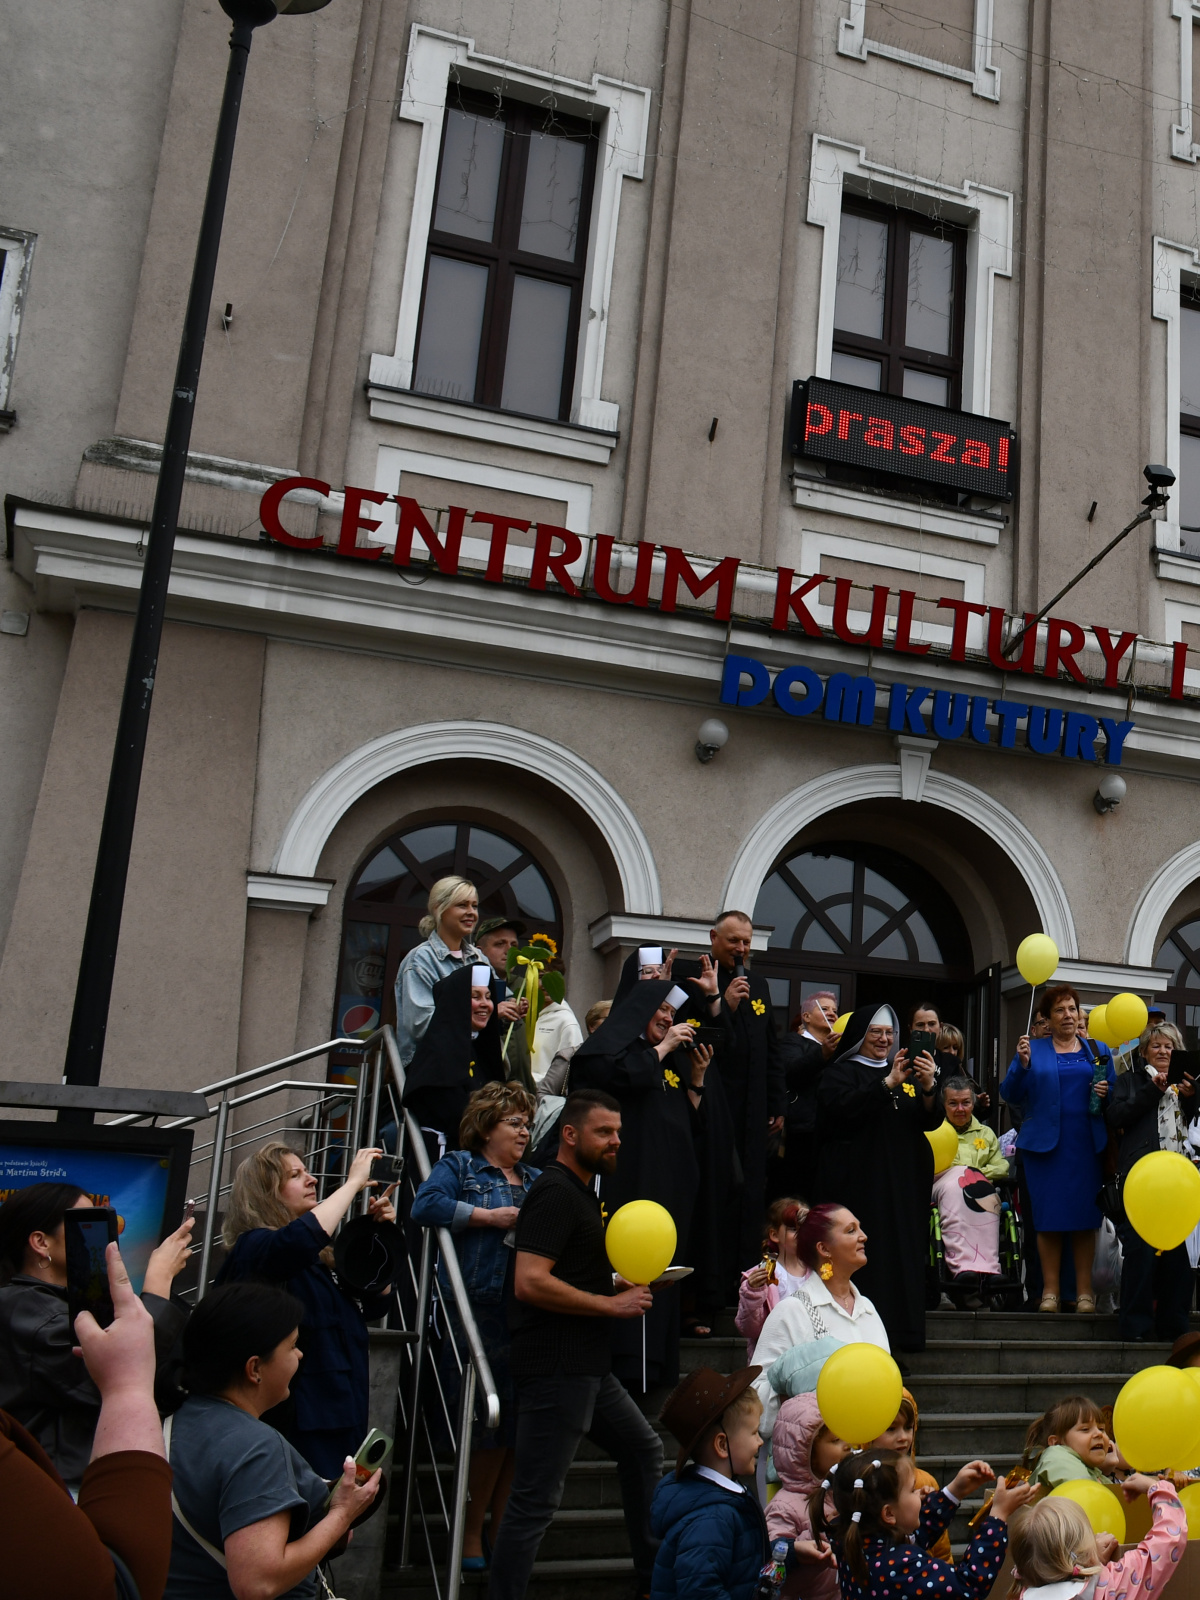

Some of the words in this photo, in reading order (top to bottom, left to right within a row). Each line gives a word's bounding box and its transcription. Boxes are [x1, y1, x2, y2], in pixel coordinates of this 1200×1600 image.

[259, 476, 741, 621] CENTRUM
[771, 566, 1138, 688] KULTURY
[1169, 641, 1189, 700] I
[720, 654, 877, 726] DOM
[887, 682, 1136, 766] KULTURY
[5, 1168, 38, 1177] Martina
